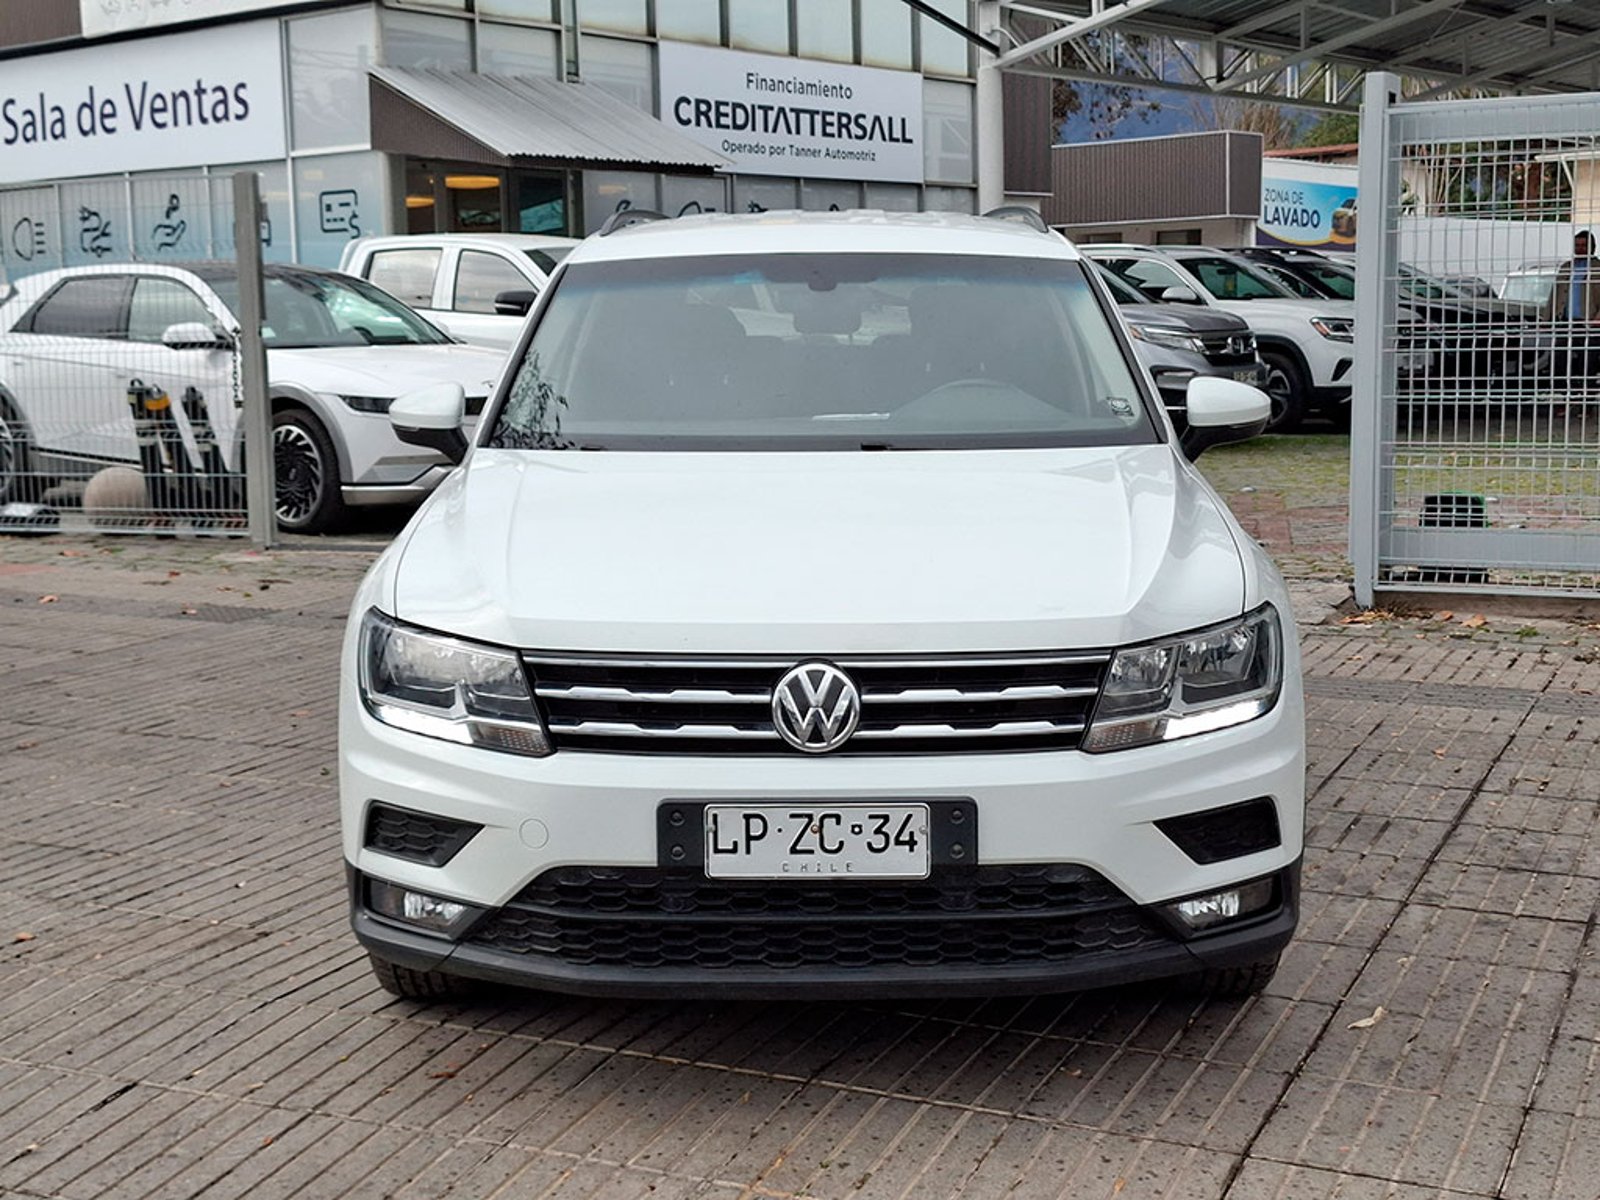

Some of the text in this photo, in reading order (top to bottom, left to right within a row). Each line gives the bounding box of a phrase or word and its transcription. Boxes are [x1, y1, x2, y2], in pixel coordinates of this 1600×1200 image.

[746, 72, 853, 100] Financiamiento
[2, 78, 250, 146] Sala de Ventas
[673, 96, 914, 144] CREDITATTERSALL
[721, 139, 877, 162] Operado por Tanner Automotriz
[1264, 188, 1305, 206] ZONA DE
[1263, 204, 1321, 229] LAVADO
[781, 862, 854, 873] CHILE
